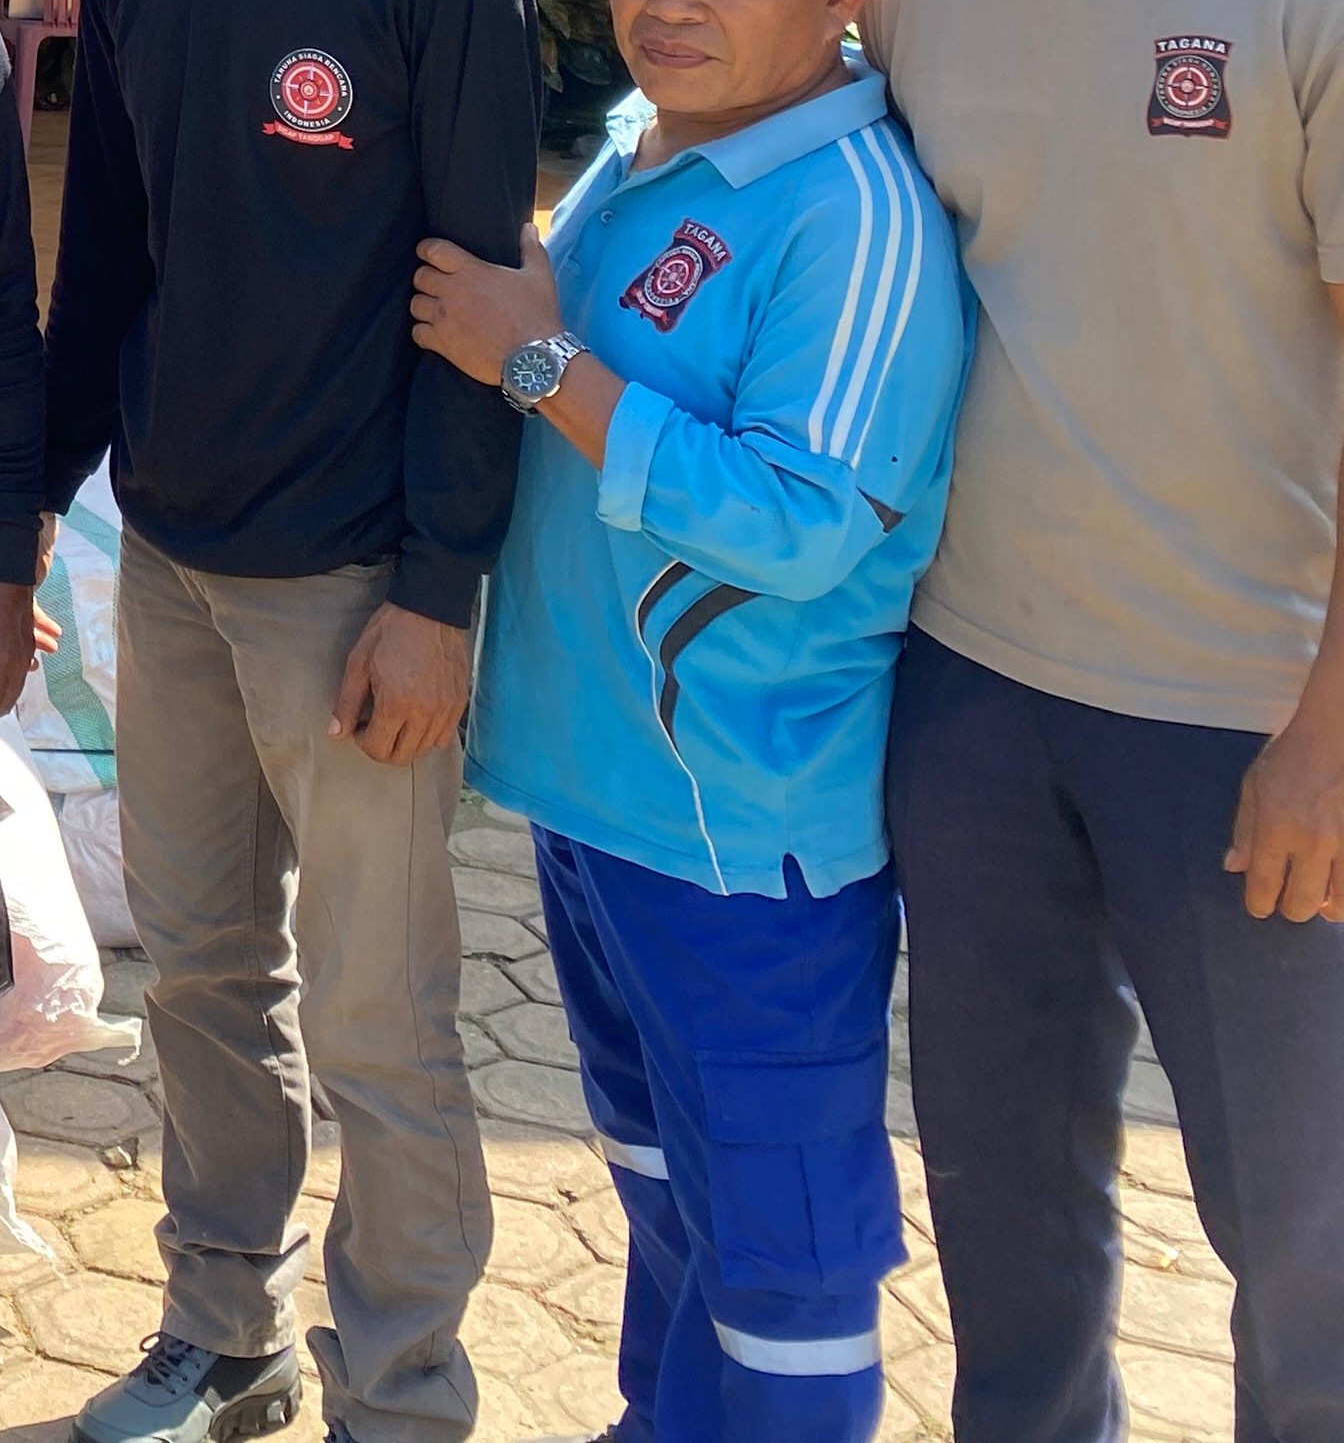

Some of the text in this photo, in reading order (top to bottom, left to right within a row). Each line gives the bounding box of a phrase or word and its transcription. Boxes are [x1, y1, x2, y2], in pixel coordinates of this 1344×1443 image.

[1157, 37, 1226, 54] TAGANA
[274, 53, 348, 97] TARUNA SIAGA BENCANA
[284, 110, 331, 128] INDONESIA
[683, 223, 727, 262] TAGANA
